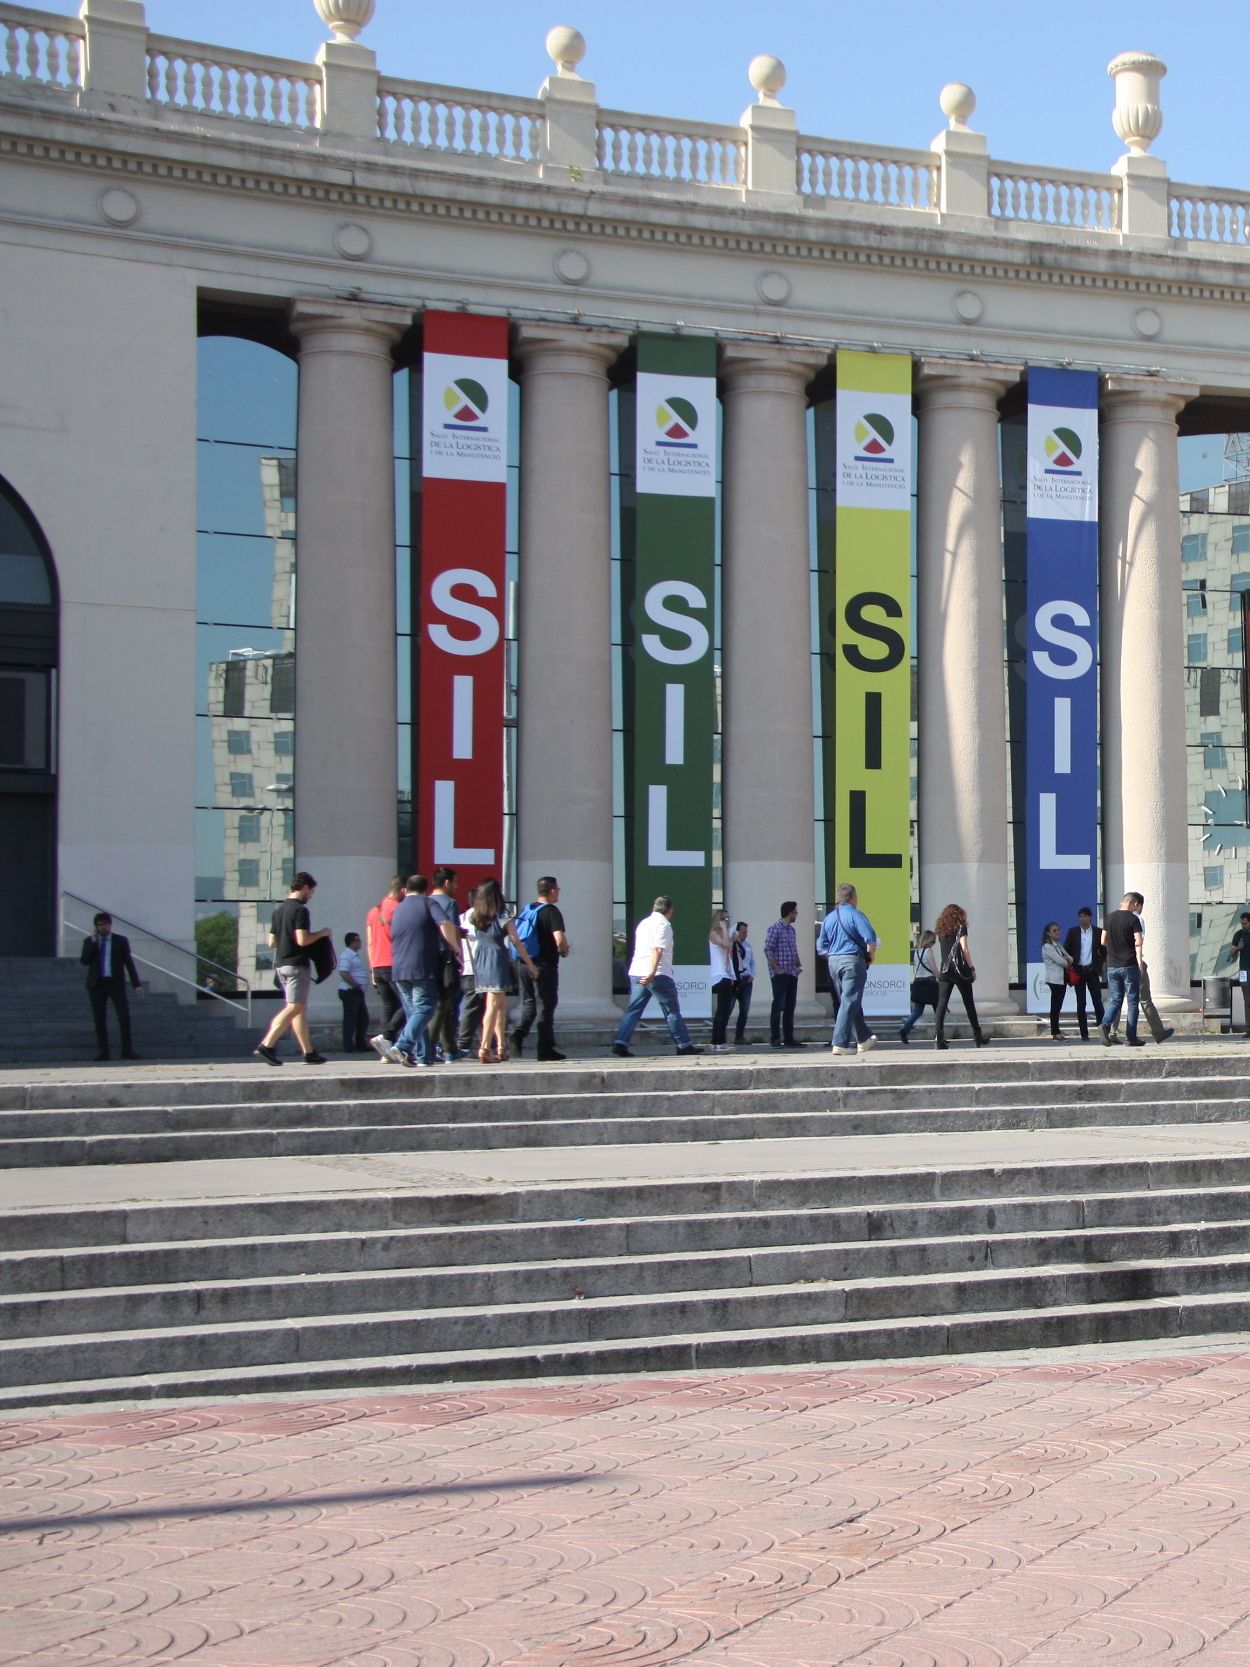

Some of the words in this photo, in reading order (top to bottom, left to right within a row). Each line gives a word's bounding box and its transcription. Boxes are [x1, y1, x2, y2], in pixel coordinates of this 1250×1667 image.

[444, 441, 453, 449] LA
[428, 568, 500, 865] SIL
[641, 580, 709, 867] SIL
[842, 592, 905, 868] SIL
[1032, 600, 1093, 869] SIL
